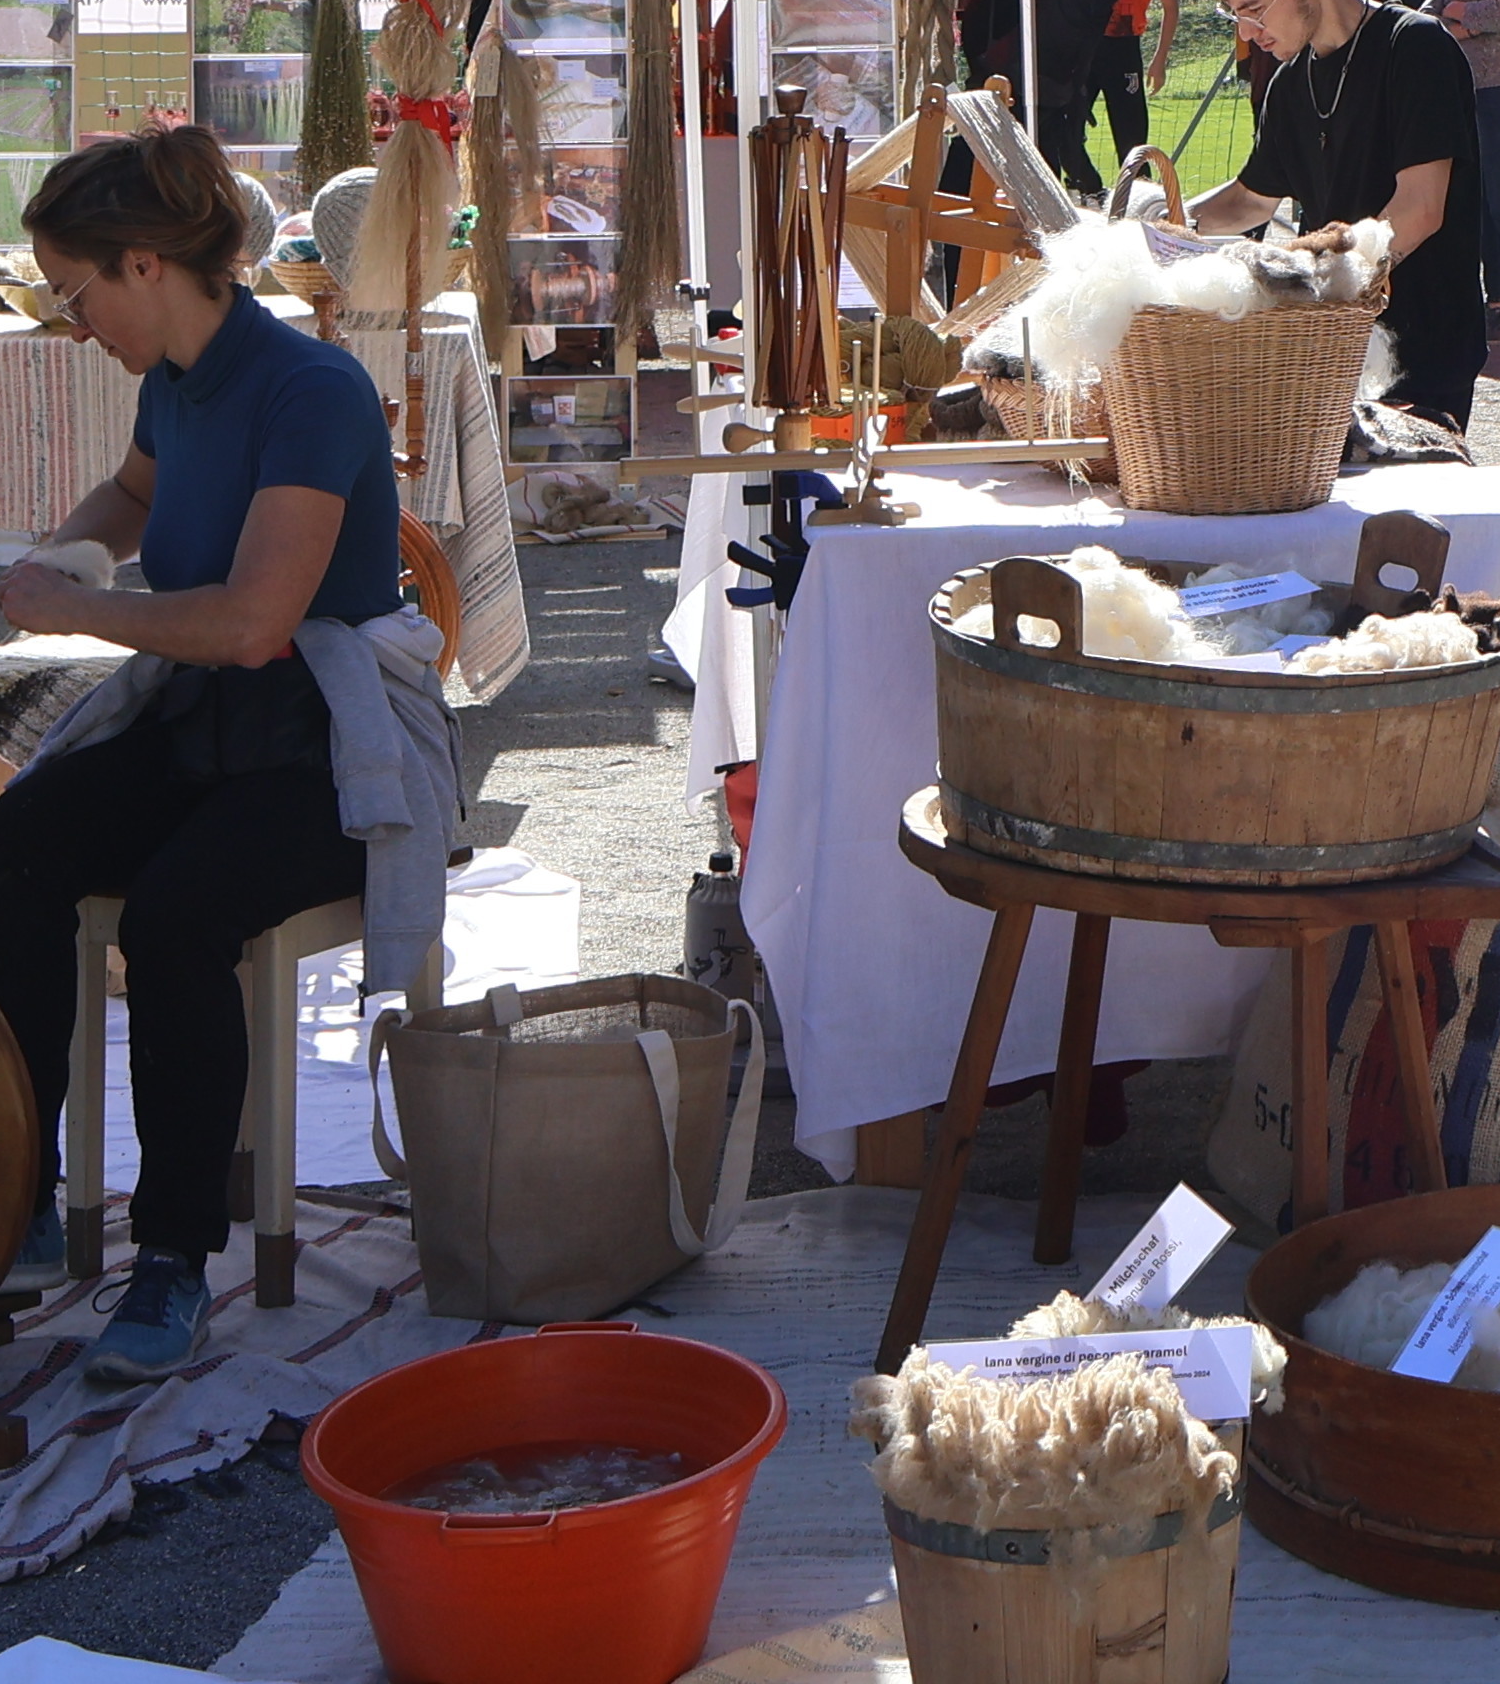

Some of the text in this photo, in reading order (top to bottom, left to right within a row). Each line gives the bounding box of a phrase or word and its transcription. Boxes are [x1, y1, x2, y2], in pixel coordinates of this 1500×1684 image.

[1108, 1235, 1160, 1294] Milchschaf
[1116, 1239, 1182, 1311] Manuela Rossi,
[1413, 1331, 1431, 1350] lana
[1425, 1304, 1449, 1334] vergine
[985, 1356, 1012, 1368] lana
[1015, 1353, 1060, 1369] vergine
[1064, 1351, 1075, 1363] di
[1193, 1370, 1211, 1378] 2024
